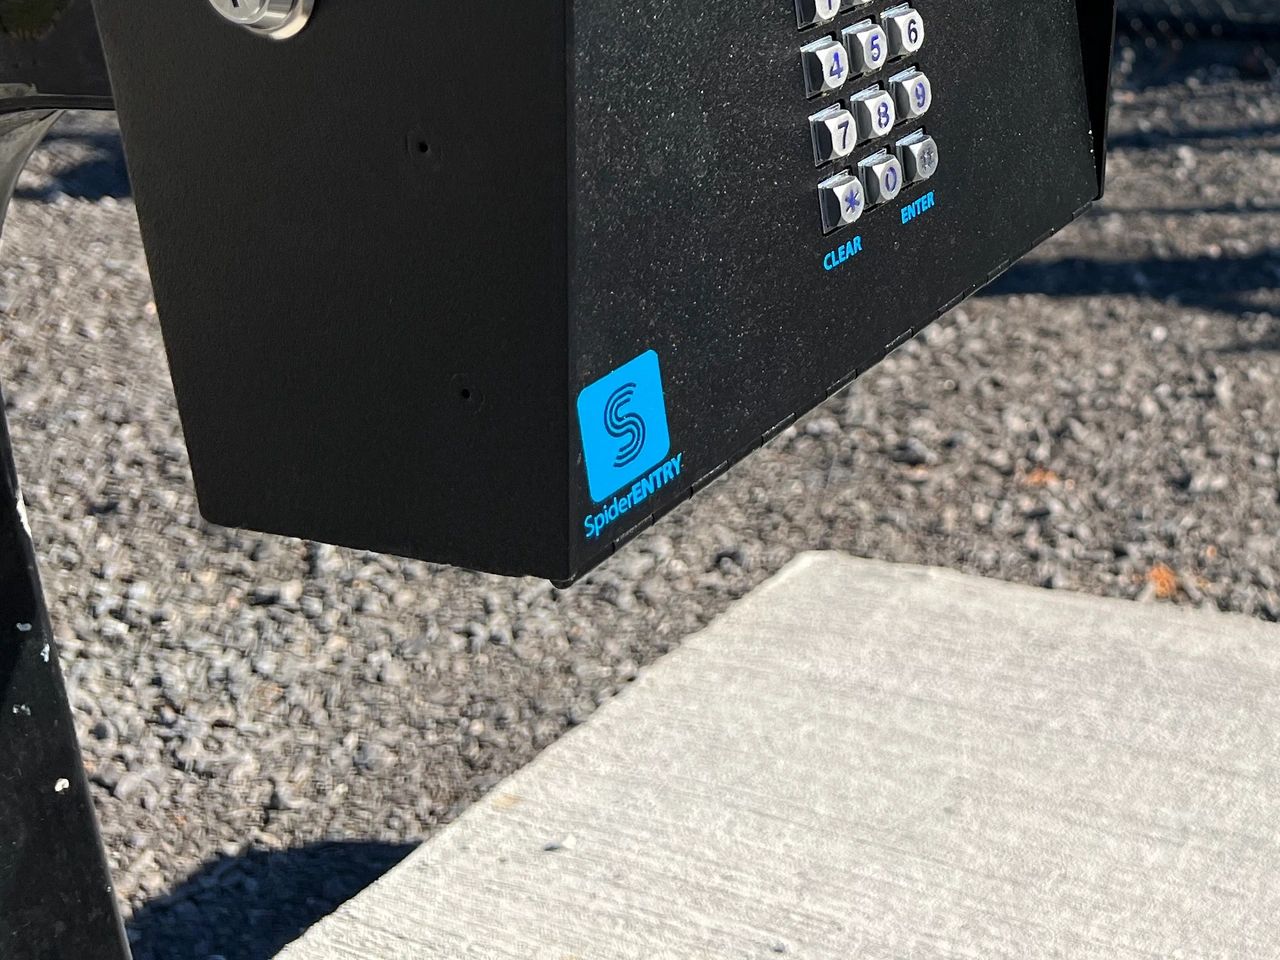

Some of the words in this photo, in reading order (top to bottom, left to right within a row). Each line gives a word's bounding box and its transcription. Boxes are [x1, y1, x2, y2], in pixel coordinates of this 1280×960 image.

[829, 51, 844, 80] 4
[871, 34, 881, 62] 5
[907, 19, 919, 45] 6
[837, 120, 850, 150] 7
[877, 102, 889, 129] 8
[914, 82, 926, 109] 9
[884, 166, 897, 193] 0
[901, 190, 935, 225] ENTER
[822, 235, 863, 271] CLEAR
[583, 452, 683, 538] SpiderENTRY
